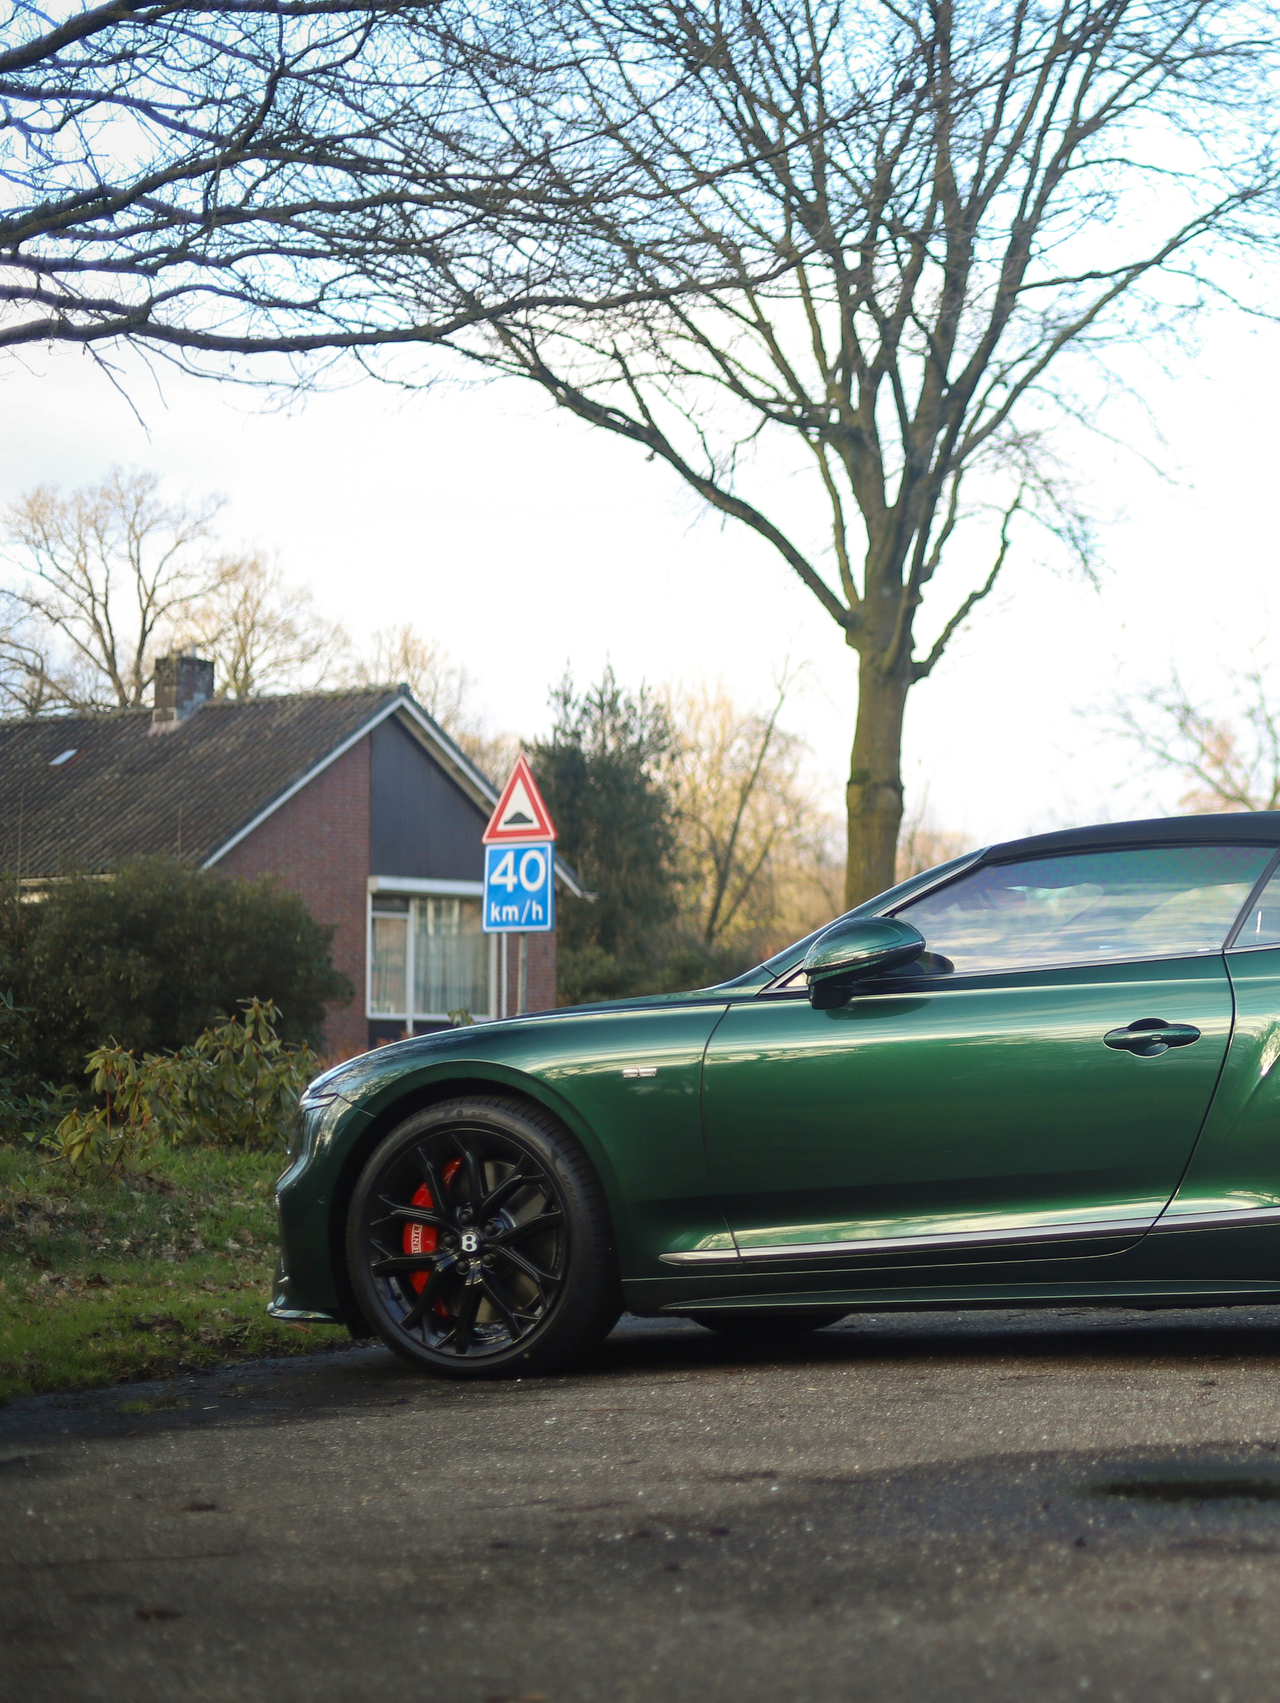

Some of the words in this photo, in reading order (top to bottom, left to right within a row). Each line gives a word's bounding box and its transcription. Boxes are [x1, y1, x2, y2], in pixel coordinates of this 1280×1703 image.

[490, 850, 546, 892] 40
[491, 899, 543, 924] km/h
[461, 1234, 478, 1252] B
